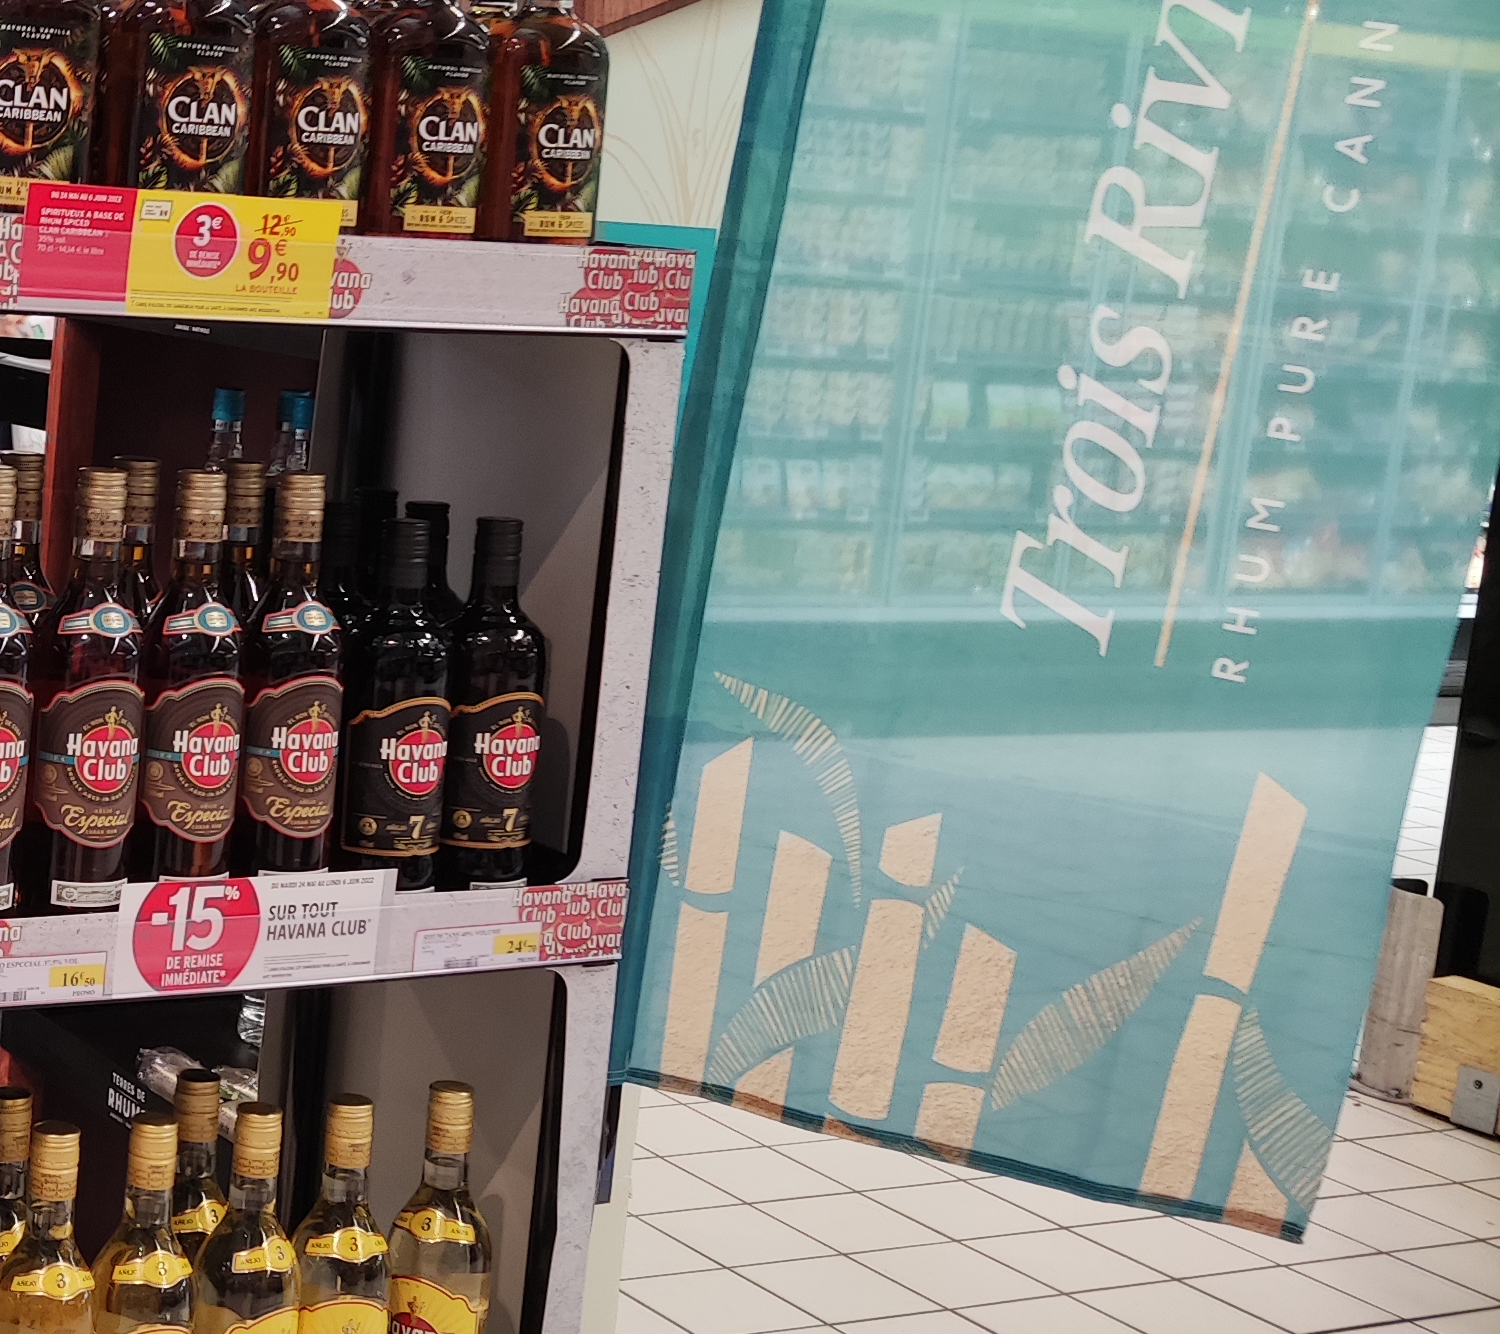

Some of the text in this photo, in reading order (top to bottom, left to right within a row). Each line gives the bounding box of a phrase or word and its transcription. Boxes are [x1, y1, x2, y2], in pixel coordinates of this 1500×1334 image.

[167, 96, 237, 126] CLAN
[297, 106, 360, 134] CLAN
[172, 123, 231, 138] CARIBBEAN
[302, 130, 356, 147] CARIBBEAN
[418, 116, 479, 143] CLAN
[537, 123, 595, 149] CLAN
[235, 285, 249, 294] LA
[251, 285, 298, 295] BOUTEILLE
[1000, 302, 1174, 657] Trois
[1212, 495, 1285, 684] RHUM
[1268, 268, 1342, 442] PURE
[66, 732, 139, 757] Havana
[380, 738, 448, 760] Havana
[83, 757, 127, 781] Club
[396, 761, 439, 783] Club
[61, 804, 131, 834] Especial
[269, 901, 338, 921] SUR TOUT
[267, 922, 327, 941] HAVANA
[166, 953, 223, 970] DE REMISE
